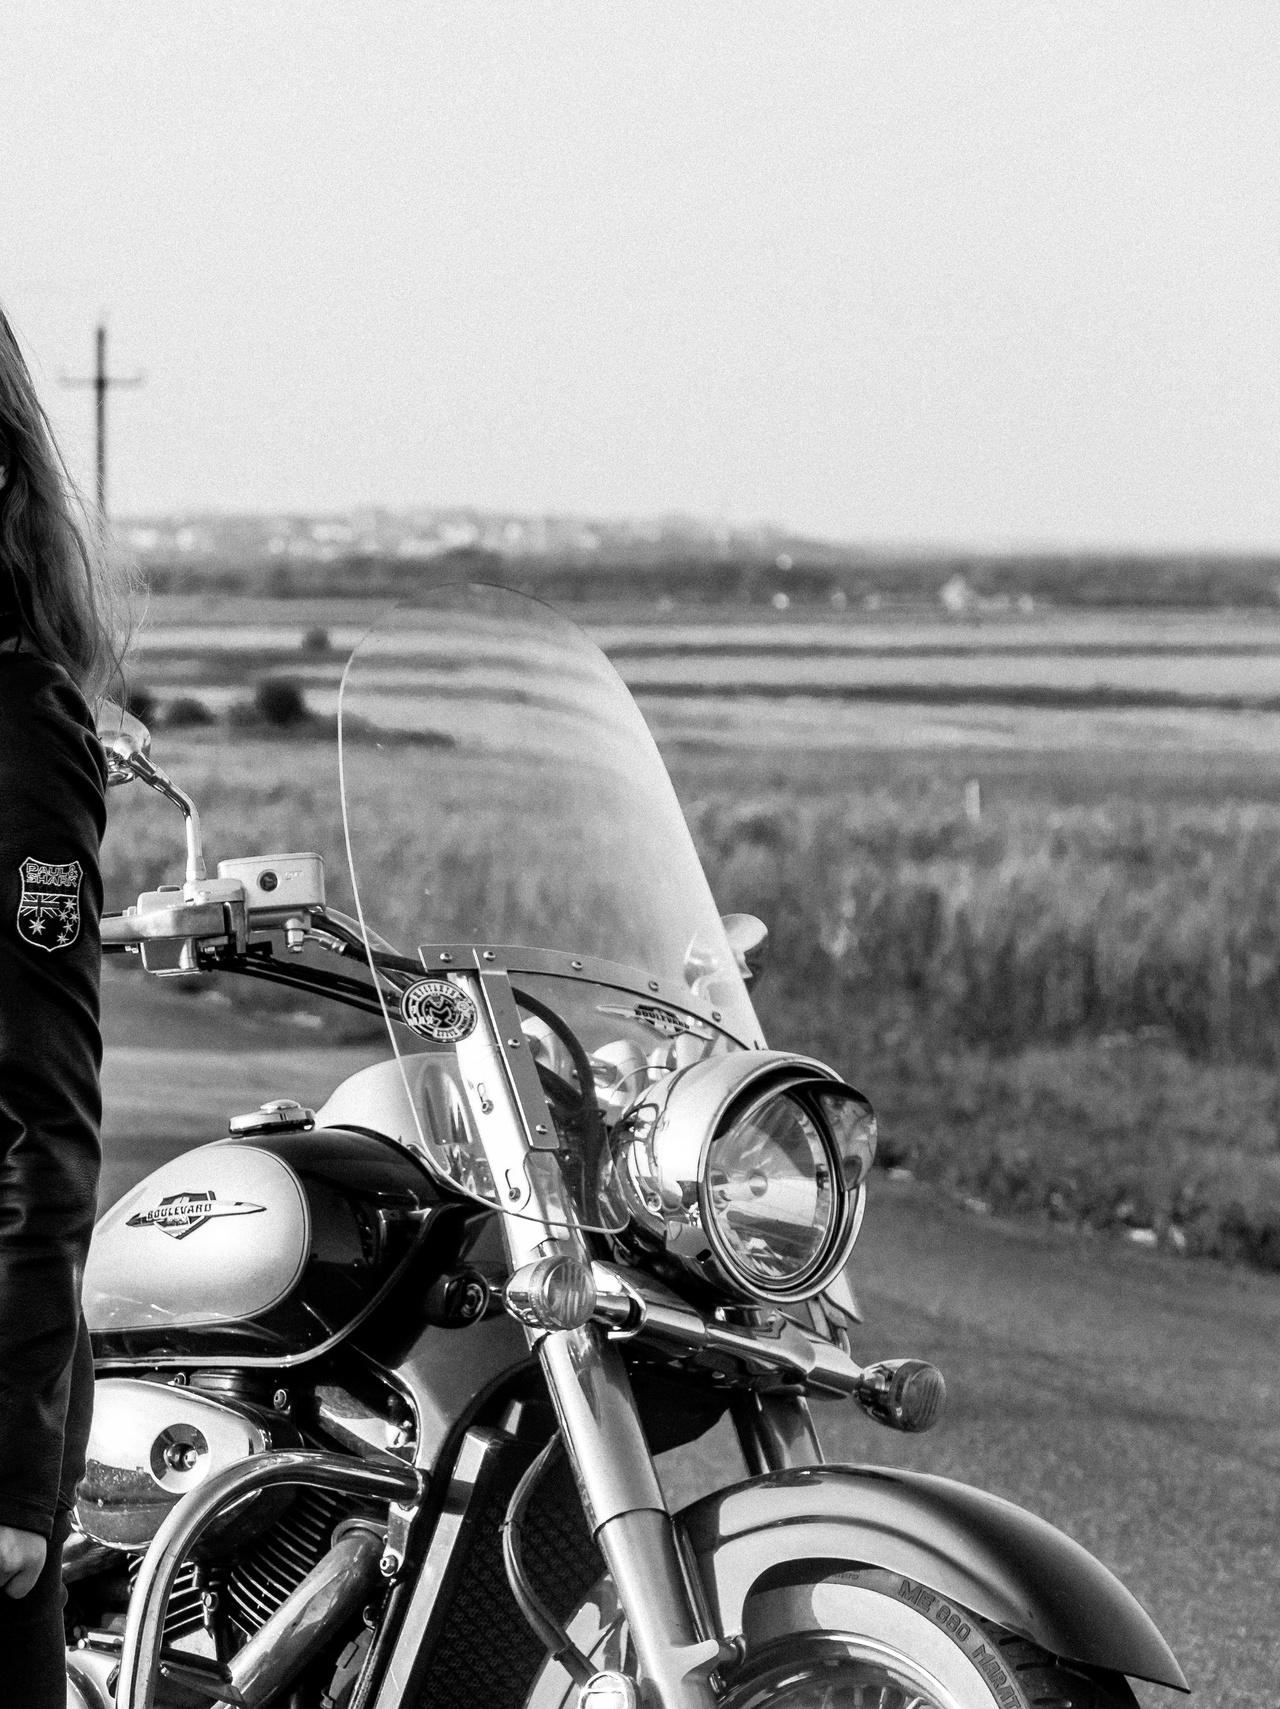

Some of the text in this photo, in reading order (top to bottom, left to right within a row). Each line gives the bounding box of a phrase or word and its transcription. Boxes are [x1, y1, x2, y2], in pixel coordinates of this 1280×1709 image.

[26, 872, 78, 887] SHARK
[634, 1009, 690, 1030] BOULEVARD
[147, 1203, 212, 1220] BOULEVARD
[898, 1579, 936, 1613] ME
[935, 1604, 971, 1642] 880
